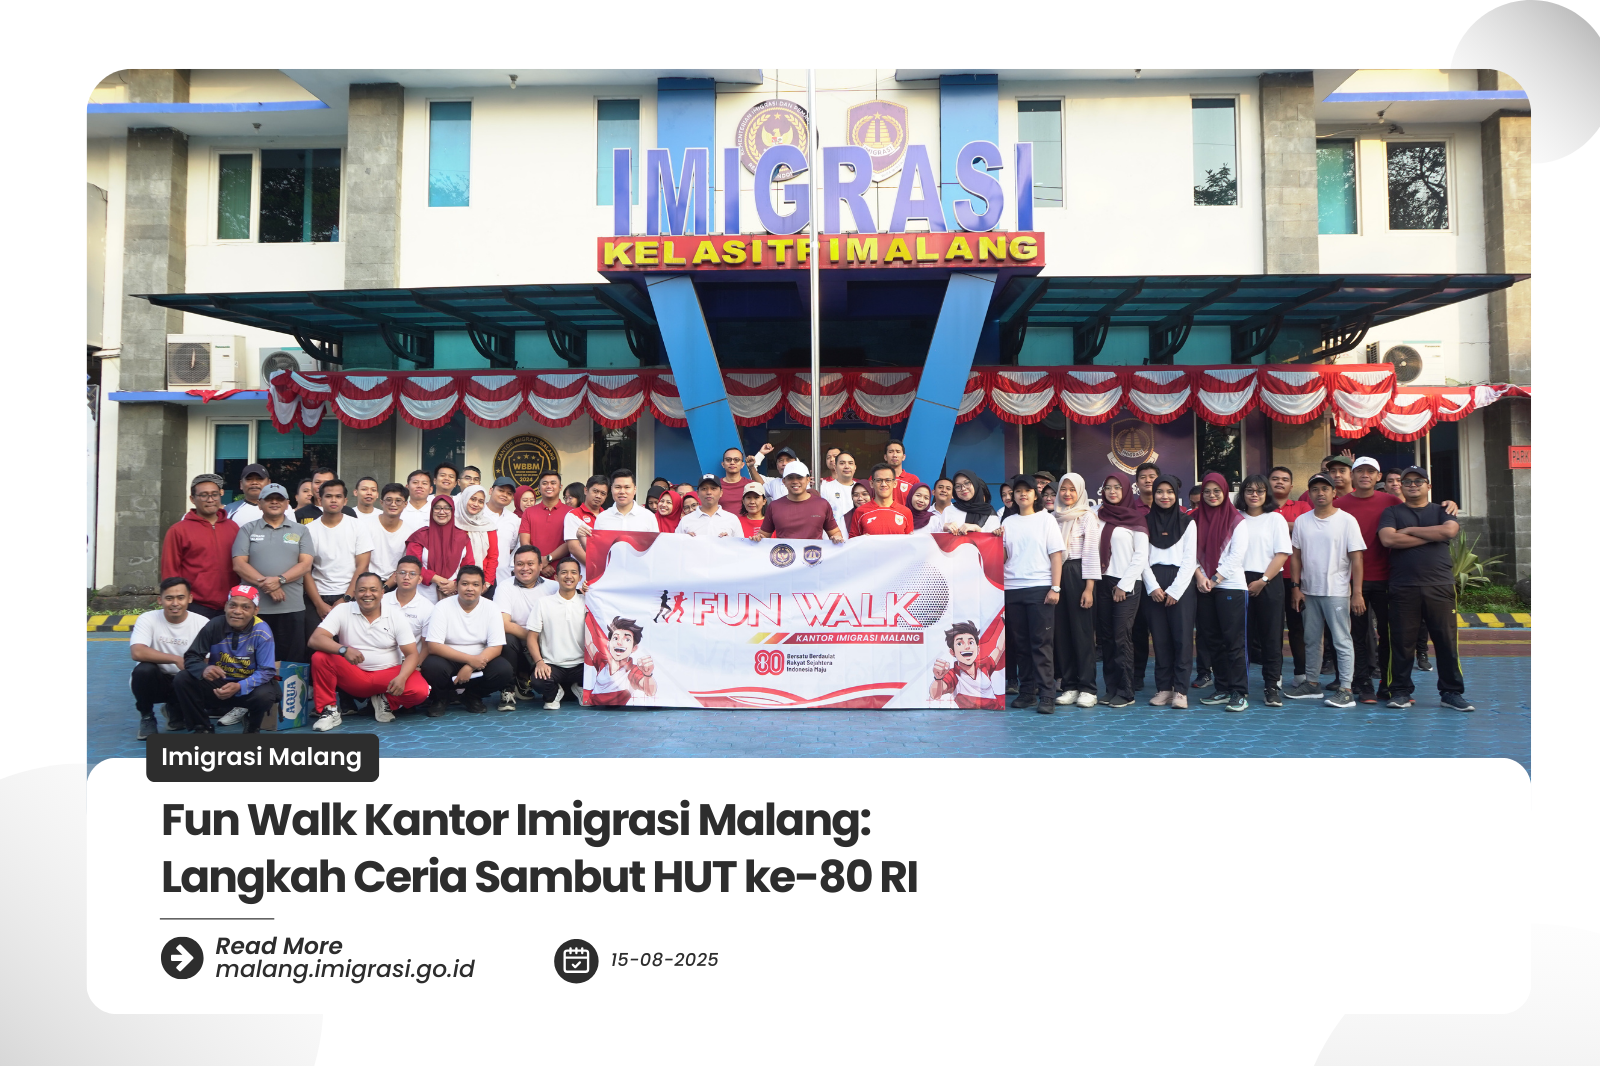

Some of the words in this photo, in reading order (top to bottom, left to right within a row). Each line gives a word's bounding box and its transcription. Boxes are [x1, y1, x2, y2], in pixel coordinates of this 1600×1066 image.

[779, 101, 793, 109] DAN
[612, 140, 1035, 236] IMIGRASI
[846, 236, 1038, 263] MALANG
[498, 442, 513, 461] KANTOR
[539, 441, 556, 461] MALANG
[1512, 450, 1531, 463] PARK
[692, 592, 782, 627] FUN
[791, 592, 924, 628] WALK
[796, 634, 834, 643] KANTOR
[836, 634, 879, 643] IMIGRASI
[881, 634, 921, 643] MALANG
[754, 650, 785, 676] 80
[285, 680, 298, 714] AQUA
